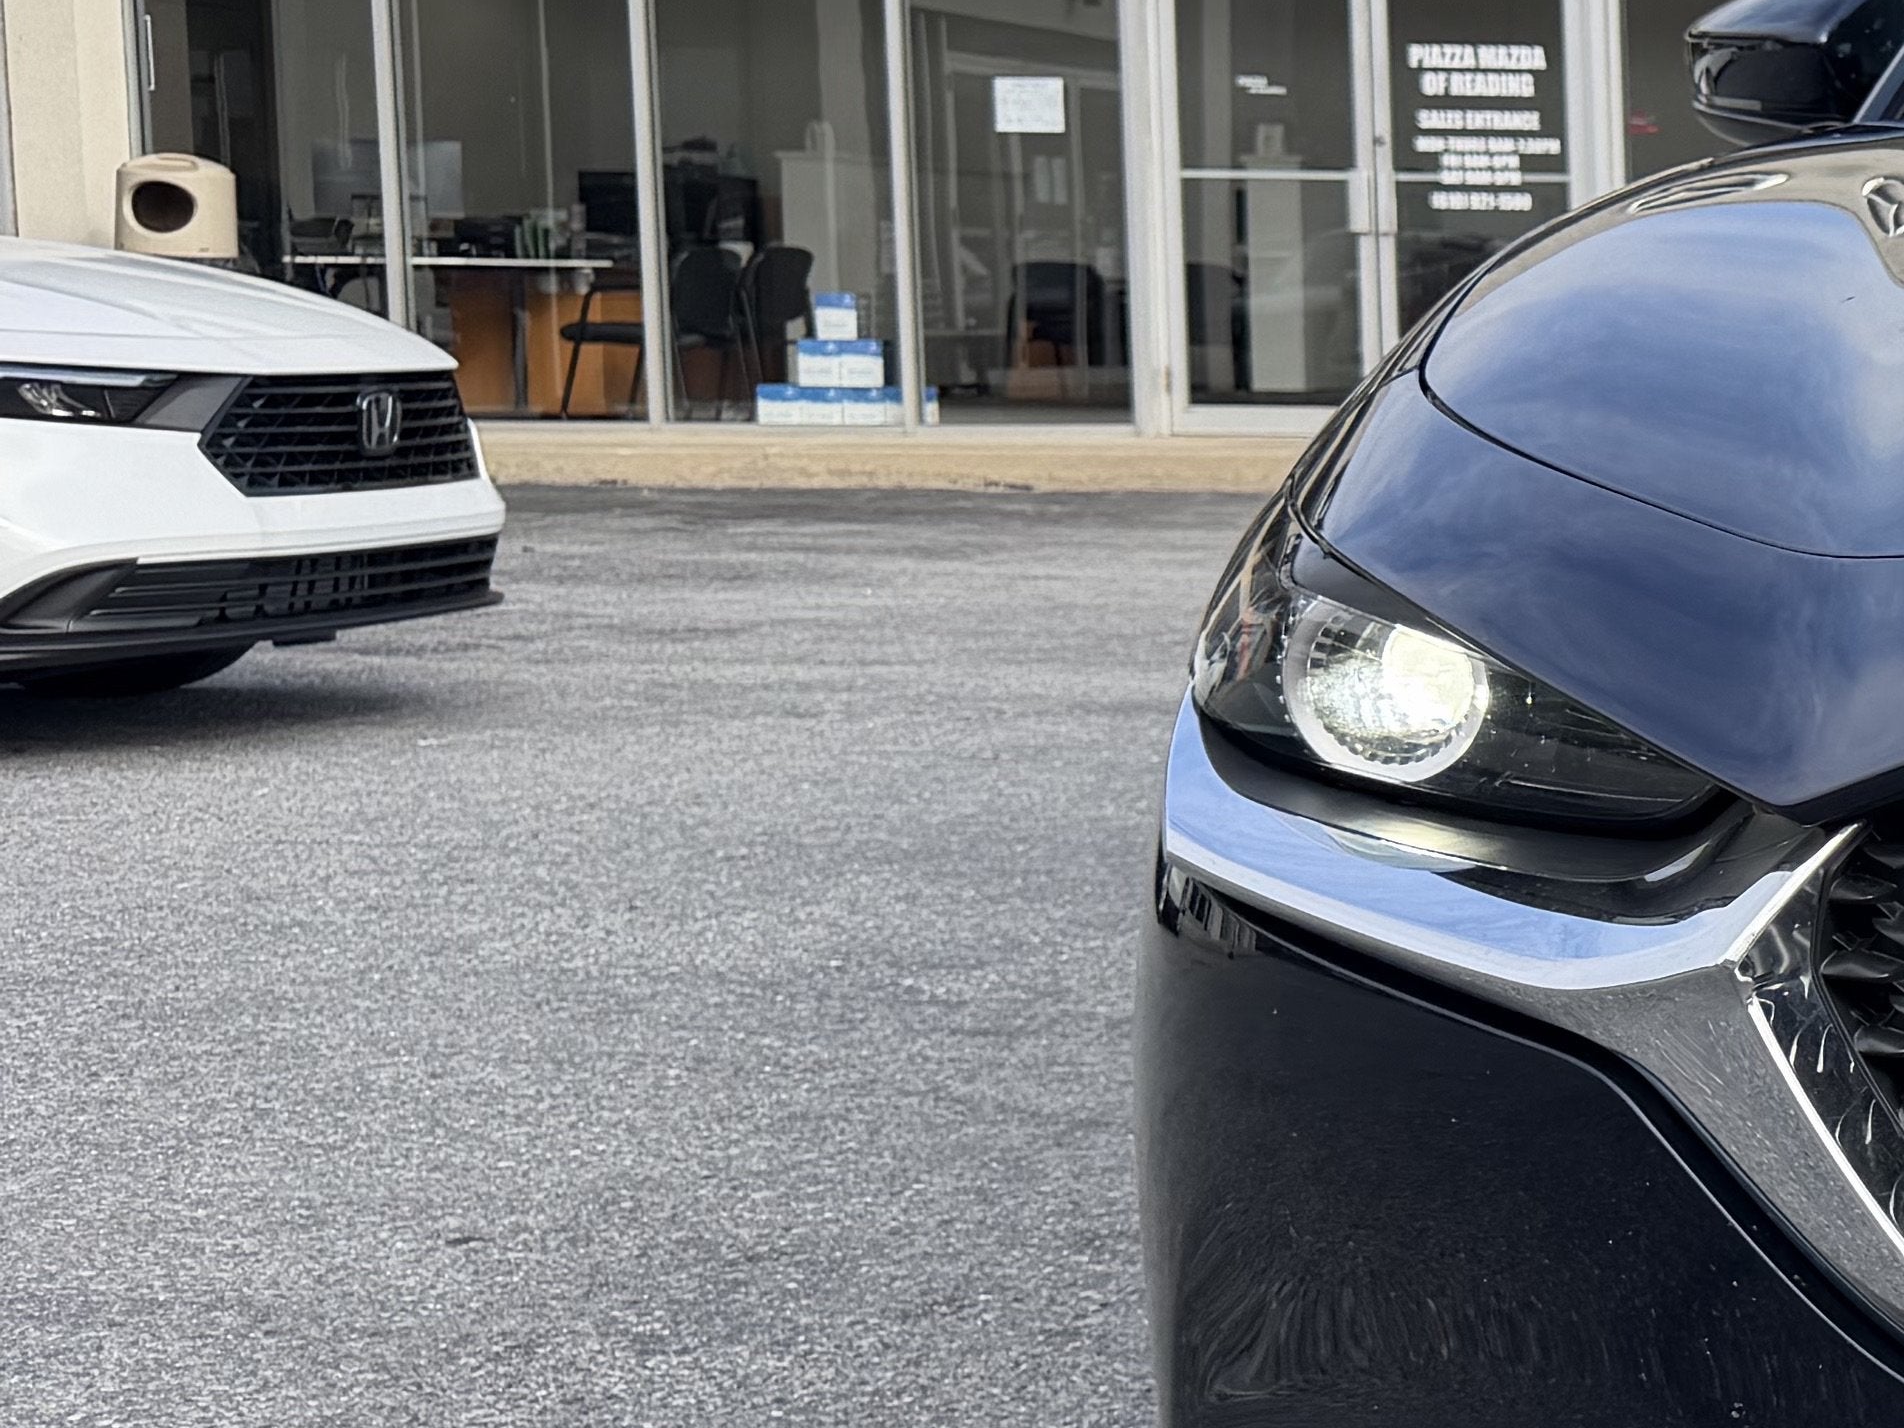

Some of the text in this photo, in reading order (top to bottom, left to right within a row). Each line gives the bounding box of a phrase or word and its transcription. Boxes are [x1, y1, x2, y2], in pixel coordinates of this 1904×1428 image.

[1406, 43, 1547, 70] PIAZZA MAZDA
[1420, 71, 1535, 97] OF READING
